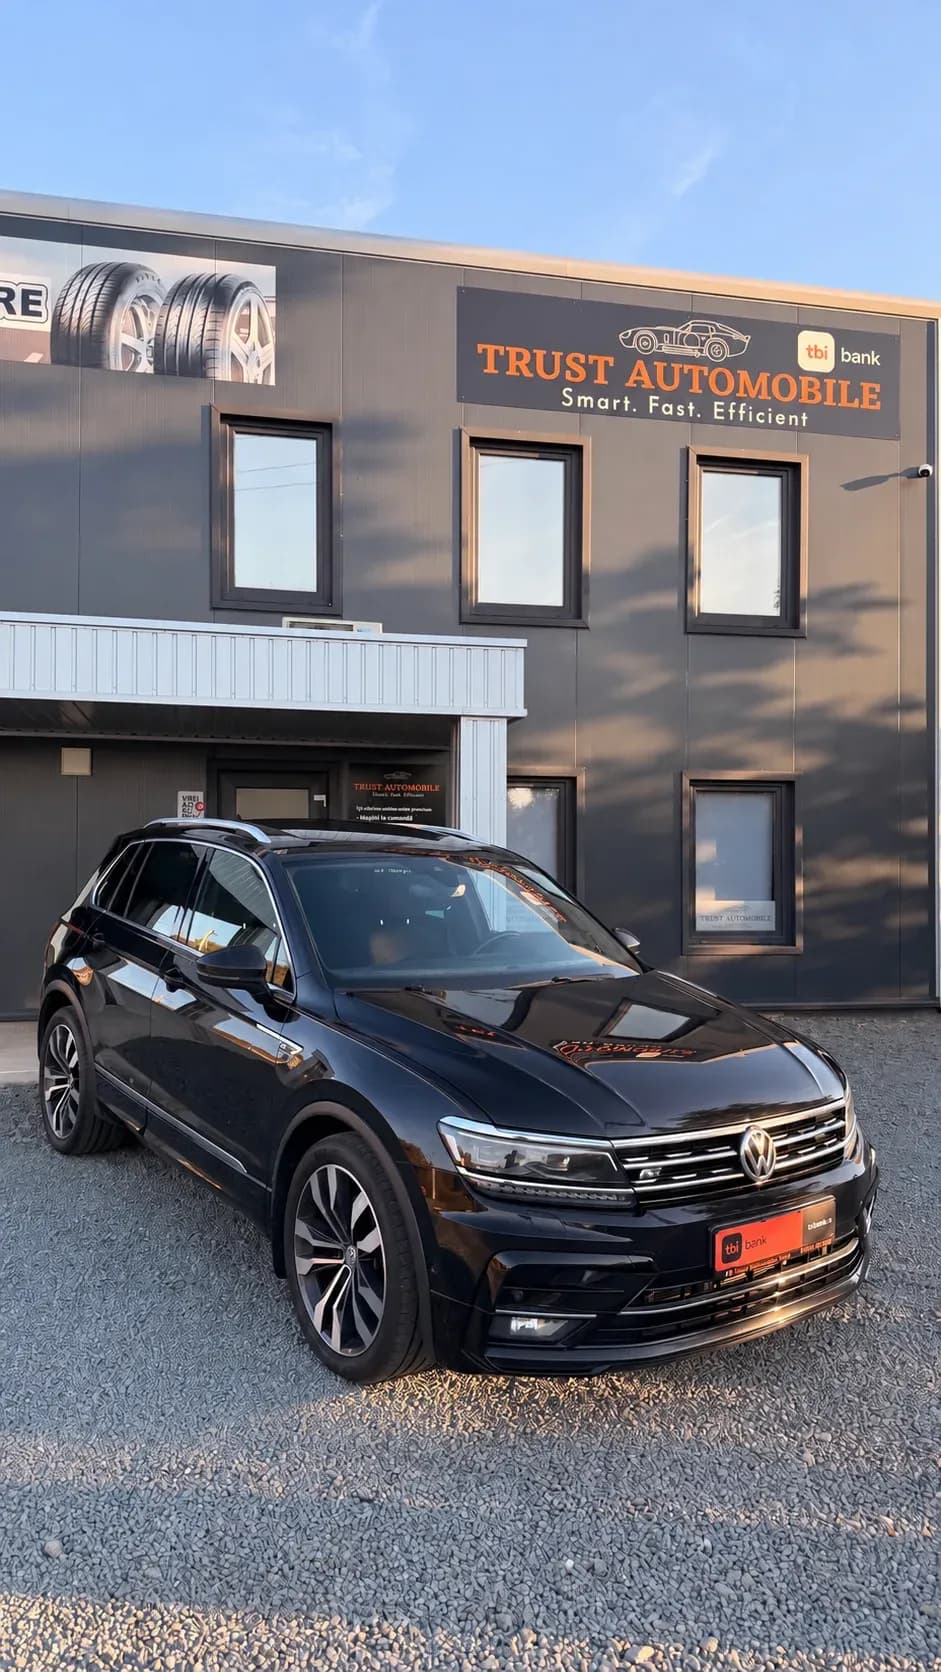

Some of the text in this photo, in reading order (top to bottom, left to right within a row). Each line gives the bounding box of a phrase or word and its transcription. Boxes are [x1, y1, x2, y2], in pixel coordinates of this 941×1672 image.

[805, 344, 882, 367] tbi bank
[477, 343, 882, 411] TRUST AUTOMOBILE
[561, 387, 809, 427] Smart. Fast. Efficient
[354, 783, 441, 792] TRUST AUTOMOBILE
[725, 1235, 768, 1256] tbi bank
